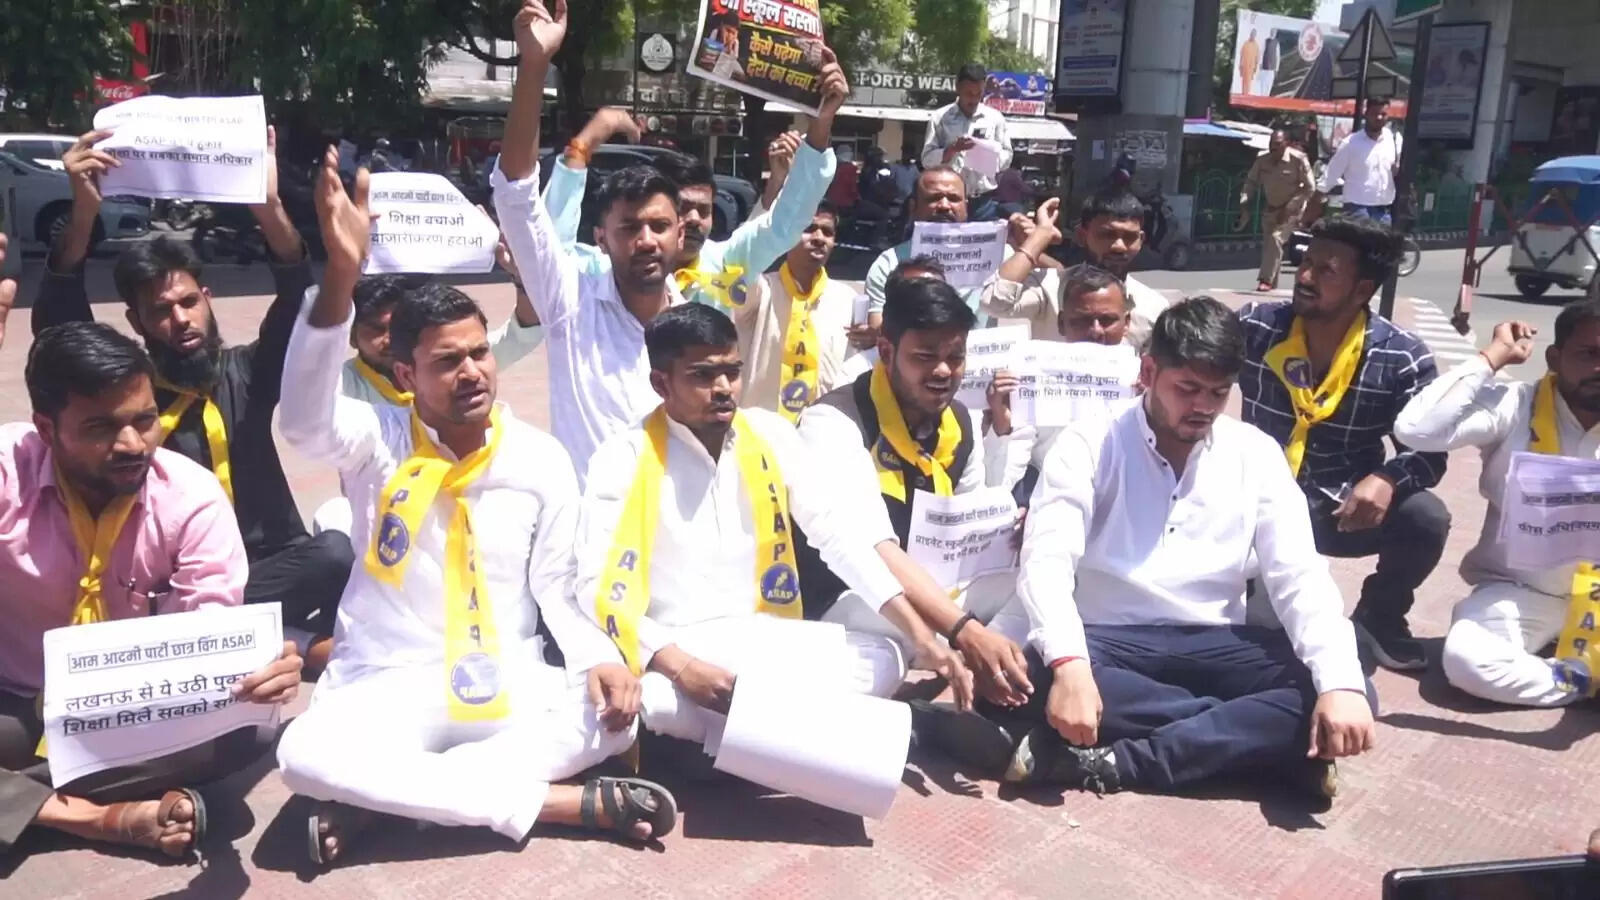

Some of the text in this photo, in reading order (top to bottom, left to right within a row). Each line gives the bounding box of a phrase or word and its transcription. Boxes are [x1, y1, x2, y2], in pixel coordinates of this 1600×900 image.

[742, 0, 782, 24] स्कूल
[749, 31, 773, 56] कैसे
[747, 53, 770, 78] देश
[769, 64, 787, 83] का
[785, 69, 814, 91] बच्चा
[853, 71, 957, 91] SPORTS WEA
[132, 151, 145, 161] पर
[213, 153, 253, 167] अधिकार
[389, 210, 464, 226] शिक्षा बचाओ
[447, 235, 483, 248] हटाओ
[1075, 373, 1093, 386] उठी
[915, 534, 942, 550] प्राइवेट
[767, 589, 794, 601] ASAP
[71, 633, 253, 670] आम आदमी पार्टी छात्र विंग ASAP
[64, 671, 251, 713] लखनऊ से ये उठी पुका
[62, 716, 110, 736] शिक्षा
[116, 705, 151, 728] मिले
[157, 697, 208, 721] सबको
